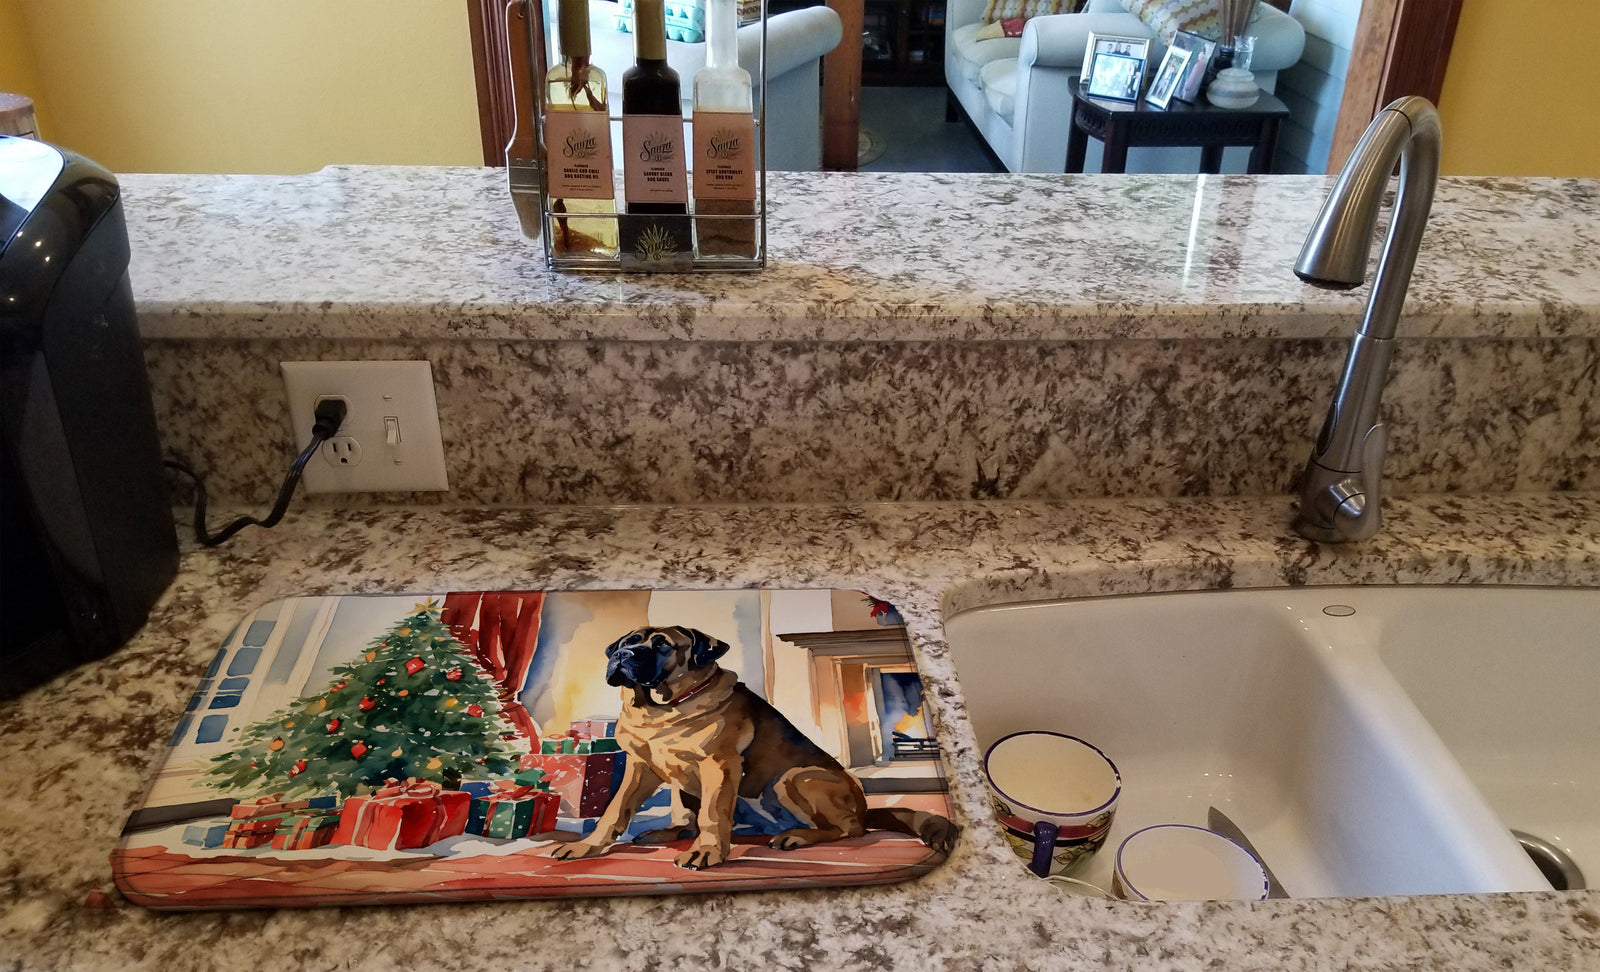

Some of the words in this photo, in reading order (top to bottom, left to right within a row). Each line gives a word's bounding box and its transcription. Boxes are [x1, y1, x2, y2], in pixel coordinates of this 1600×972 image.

[563, 136, 597, 158] Sauza
[640, 140, 673, 162] Sauza
[707, 136, 740, 158] Sauza
